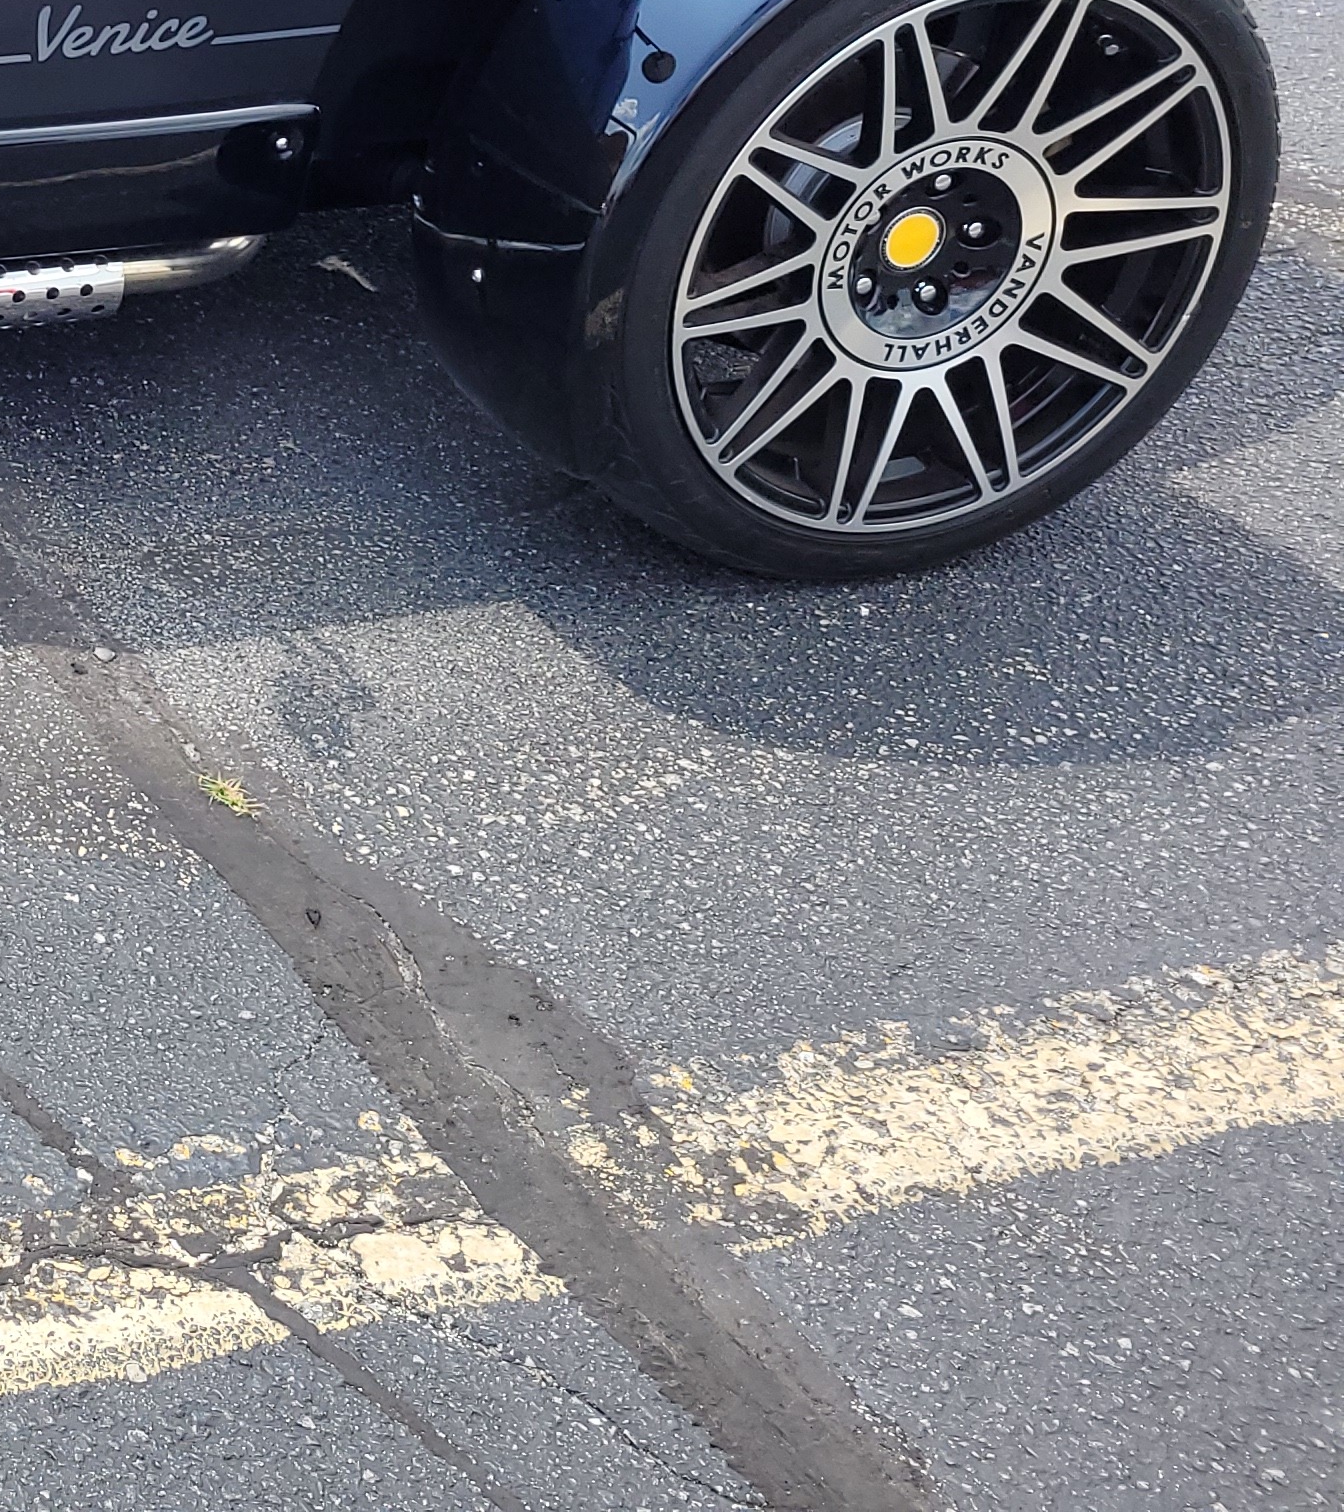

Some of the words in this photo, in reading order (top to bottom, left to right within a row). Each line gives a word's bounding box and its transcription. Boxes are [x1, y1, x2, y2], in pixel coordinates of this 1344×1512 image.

[37, 4, 215, 62] Venice
[826, 183, 893, 290] MOTOR
[901, 146, 1011, 180] WORKS
[883, 231, 1046, 363] VANDERHALL
